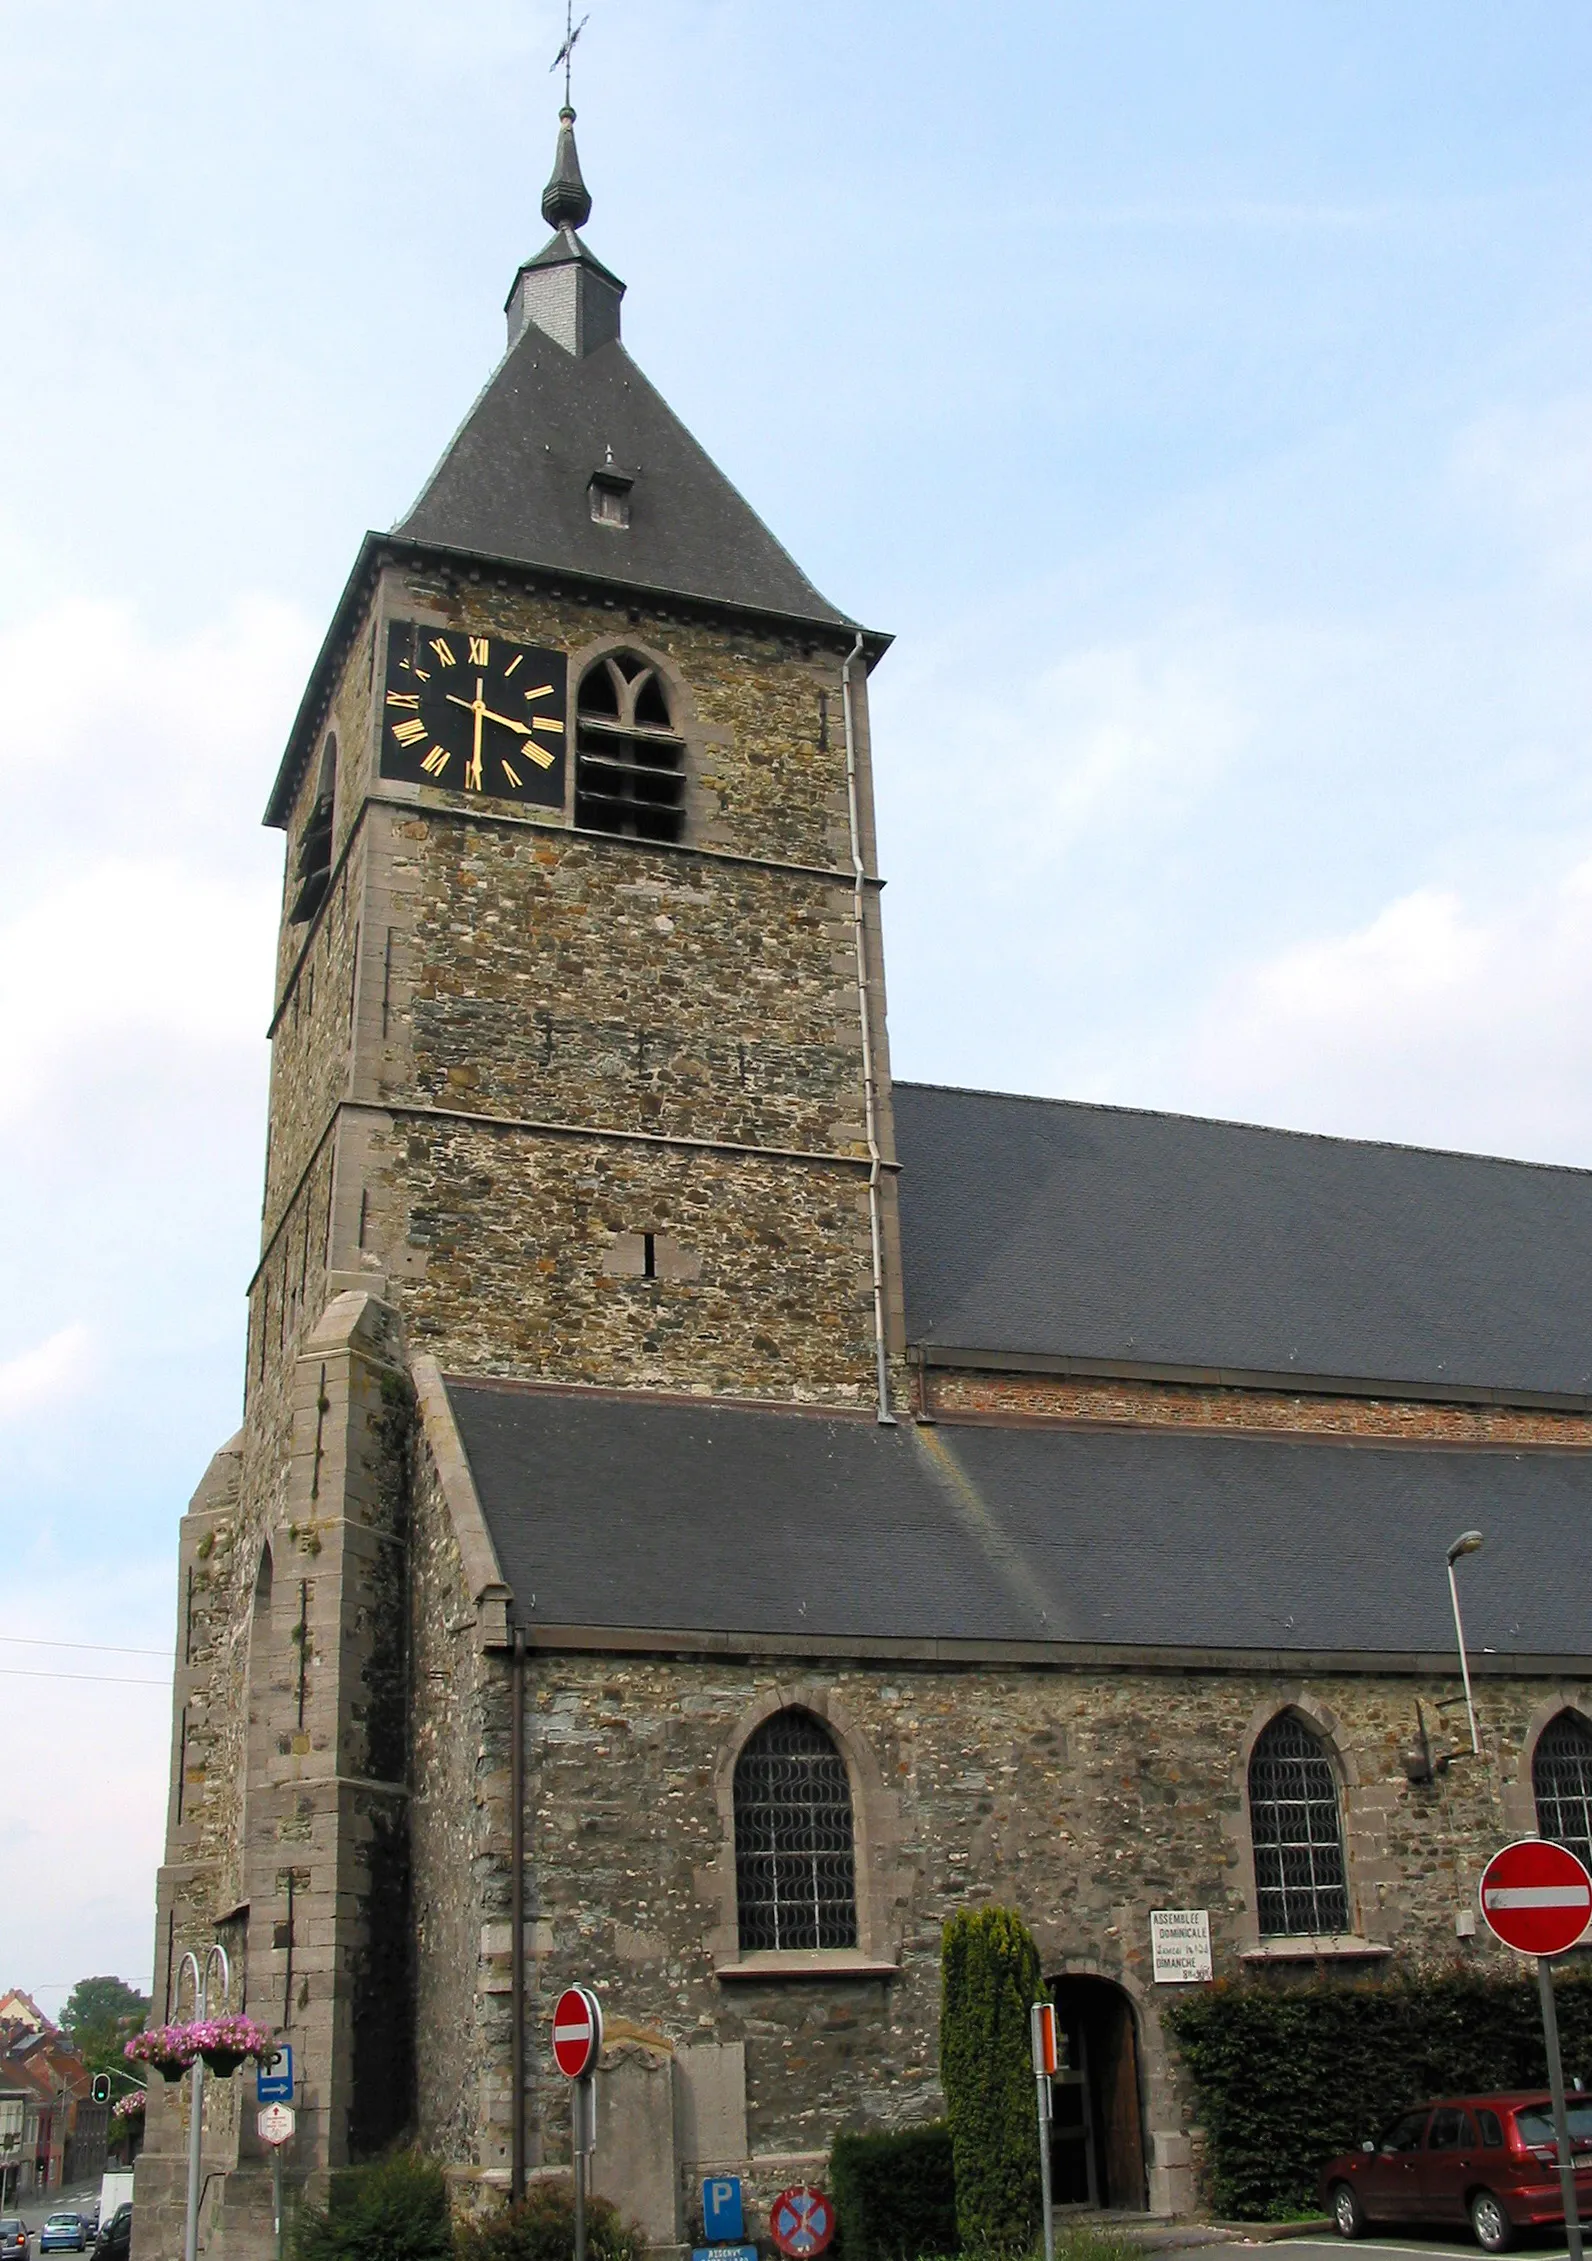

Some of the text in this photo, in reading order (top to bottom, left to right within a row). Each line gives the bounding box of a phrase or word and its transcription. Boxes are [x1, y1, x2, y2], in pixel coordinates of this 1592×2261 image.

[428, 637, 457, 667] XI
[468, 636, 490, 667] XII
[386, 690, 421, 710] IX
[524, 684, 555, 701] II
[391, 718, 429, 748] VIII
[532, 716, 564, 733] III
[420, 745, 451, 777] VII
[501, 759, 523, 788] V
[712, 2182, 733, 2215] P
